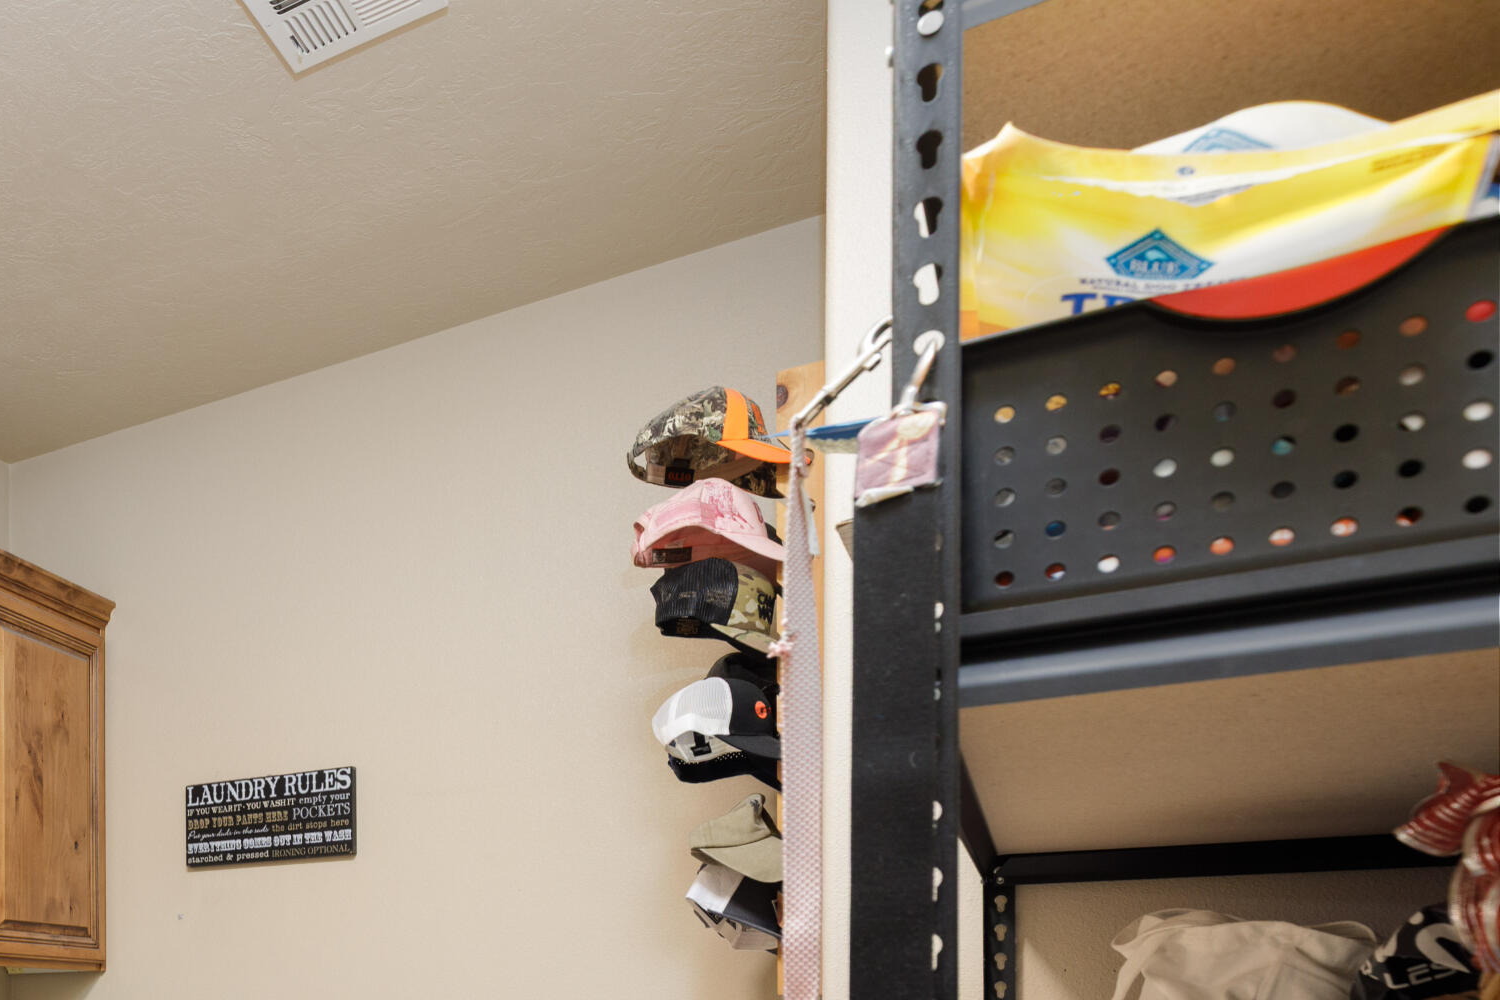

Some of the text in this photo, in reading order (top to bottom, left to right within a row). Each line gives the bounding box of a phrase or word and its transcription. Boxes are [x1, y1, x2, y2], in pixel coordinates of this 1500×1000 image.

[187, 767, 351, 807] LAUNDRY RULES
[187, 808, 195, 817] IF
[196, 806, 210, 816] YOU
[246, 801, 261, 810] YOU
[263, 798, 286, 809] WASH
[299, 793, 350, 806] empty your
[292, 802, 351, 820] POCKETS
[187, 810, 289, 831] DROP YOUR PANTS HERE
[271, 818, 350, 832] the dirt stops here
[187, 829, 352, 854] EVERYTHING COMES OUT IN THE WASH
[271, 843, 350, 858] IRONING OPTIONAL
[188, 853, 223, 864] starched
[237, 850, 269, 862] pressed
